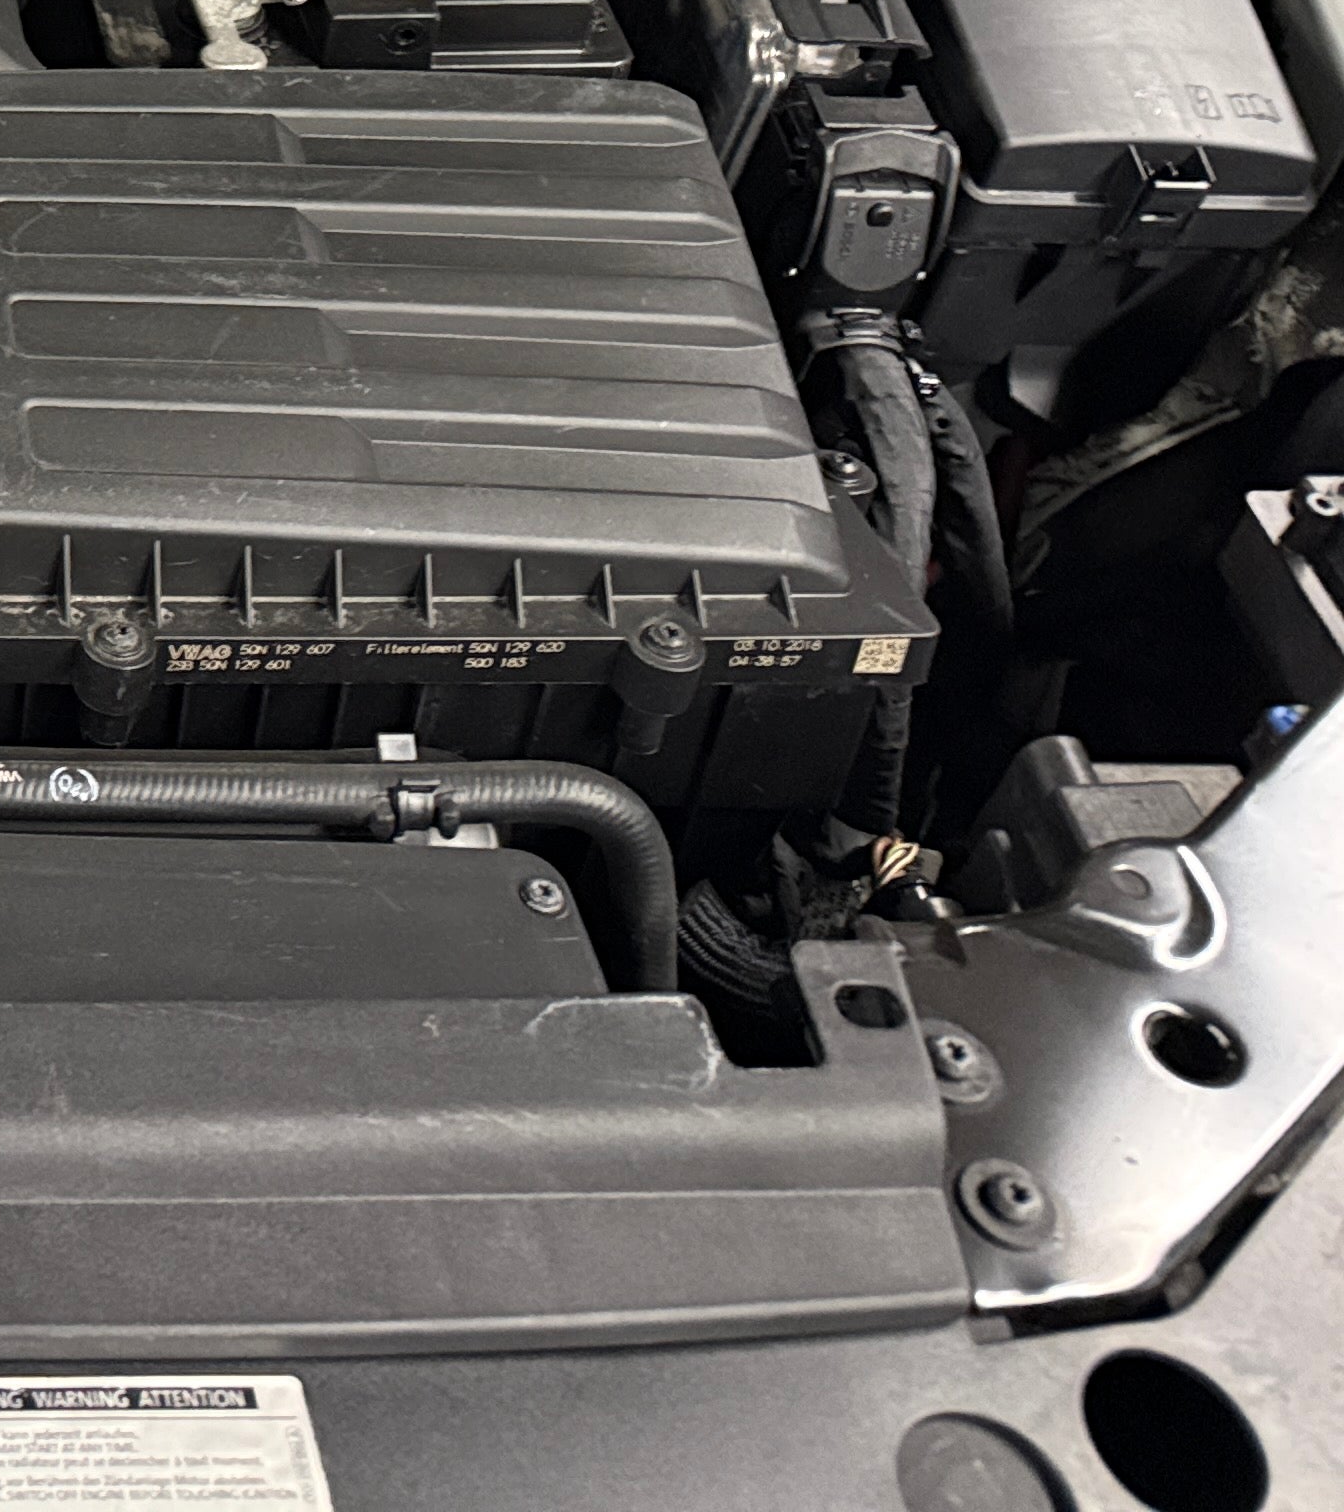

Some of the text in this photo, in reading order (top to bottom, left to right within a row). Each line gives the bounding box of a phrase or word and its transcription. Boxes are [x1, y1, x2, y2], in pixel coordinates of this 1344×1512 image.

[275, 643, 302, 655] 129
[306, 643, 335, 655] 607
[365, 643, 464, 655] Filterelement
[505, 641, 532, 653] 129
[536, 641, 566, 653] 620
[166, 660, 194, 672] ZSB
[234, 660, 261, 670] 129
[265, 659, 292, 670] 601
[31, 1389, 131, 1409] WARNING
[138, 1388, 248, 1408] ATTENTION
